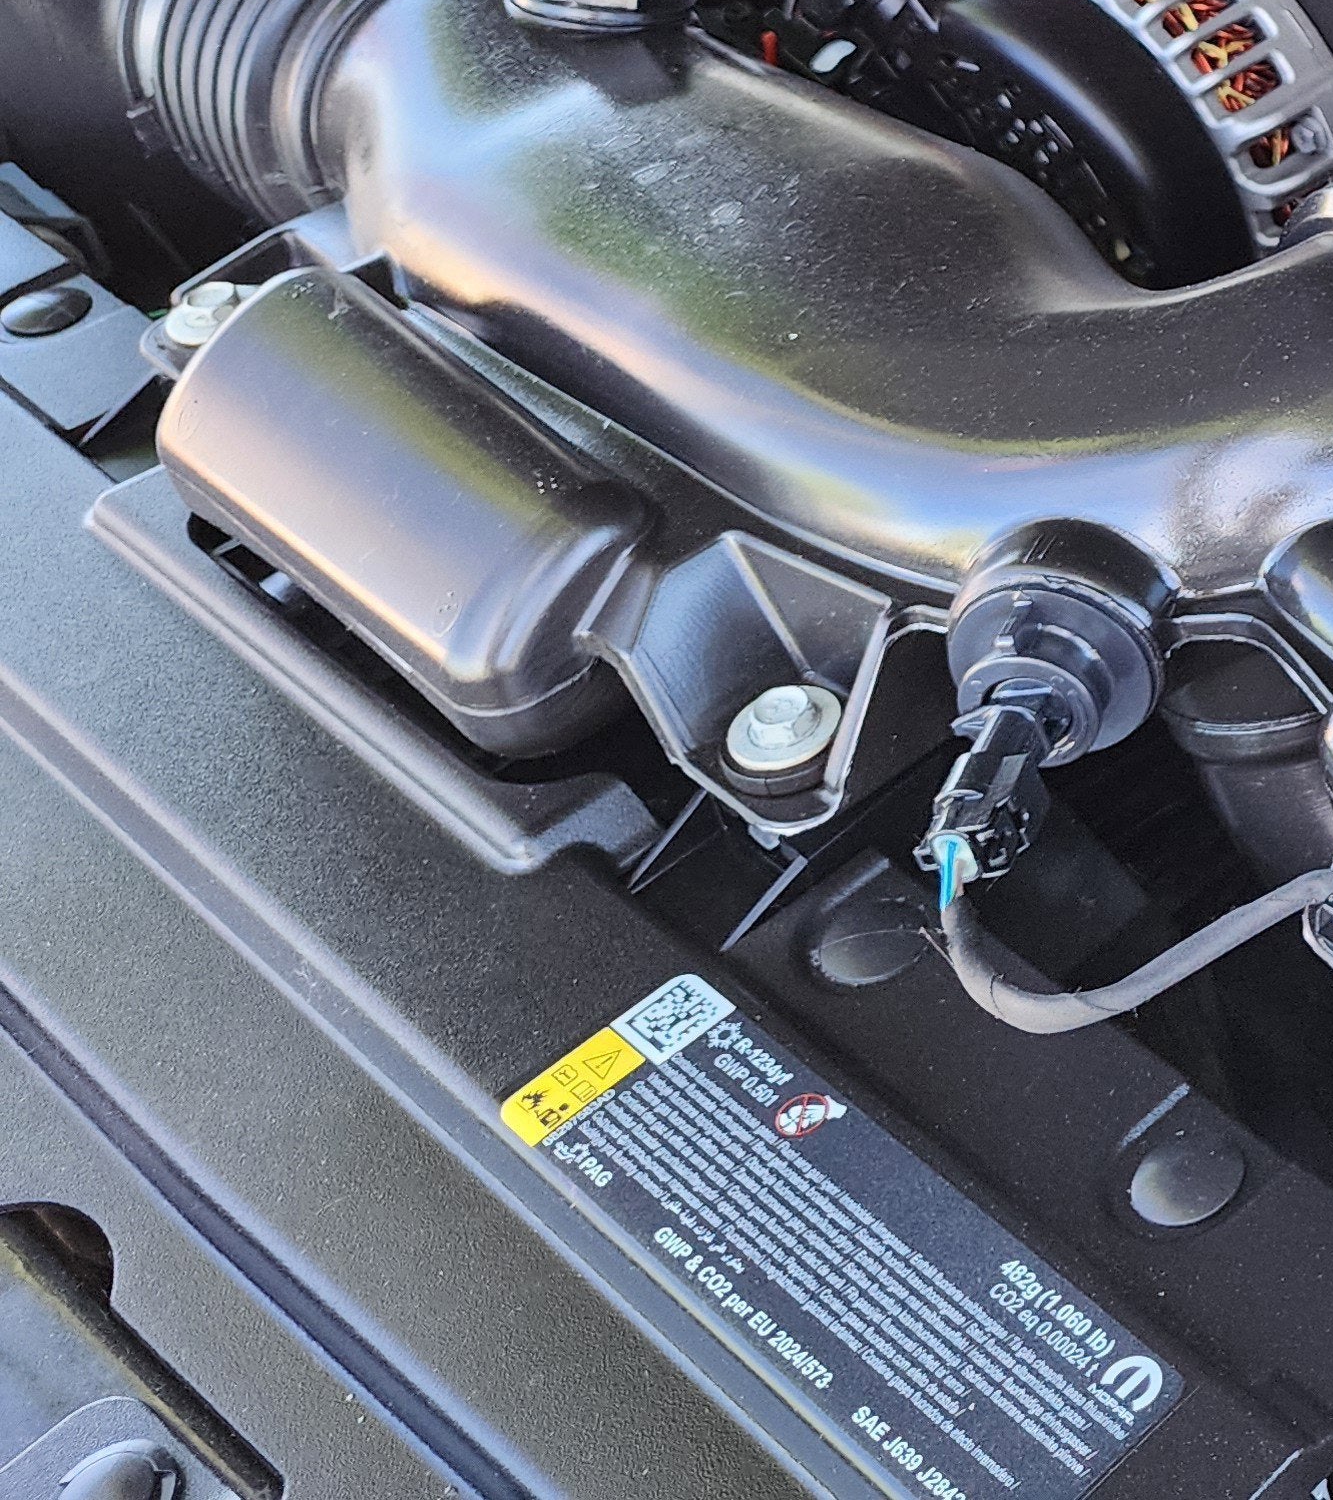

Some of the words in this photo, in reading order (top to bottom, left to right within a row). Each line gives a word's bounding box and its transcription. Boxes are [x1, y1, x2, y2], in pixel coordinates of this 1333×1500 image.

[713, 1053, 751, 1080] GWP
[740, 1076, 780, 1108] 0.501
[578, 1156, 613, 1188] PAG
[653, 1226, 693, 1259] GWP
[684, 1254, 704, 1274] &
[697, 1265, 733, 1299] CO2
[720, 1293, 754, 1318] per
[746, 1310, 778, 1337] EU
[999, 1260, 1044, 1301] 482g
[1033, 1289, 1093, 1337] (1.060
[1075, 1327, 1116, 1359] lb)
[989, 1283, 1027, 1315] CO2
[1017, 1309, 1041, 1332] eq
[1035, 1321, 1093, 1371] 0.00024
[1086, 1382, 1135, 1425] MOPAR
[851, 1405, 892, 1442] SAE
[881, 1436, 923, 1471] J639
